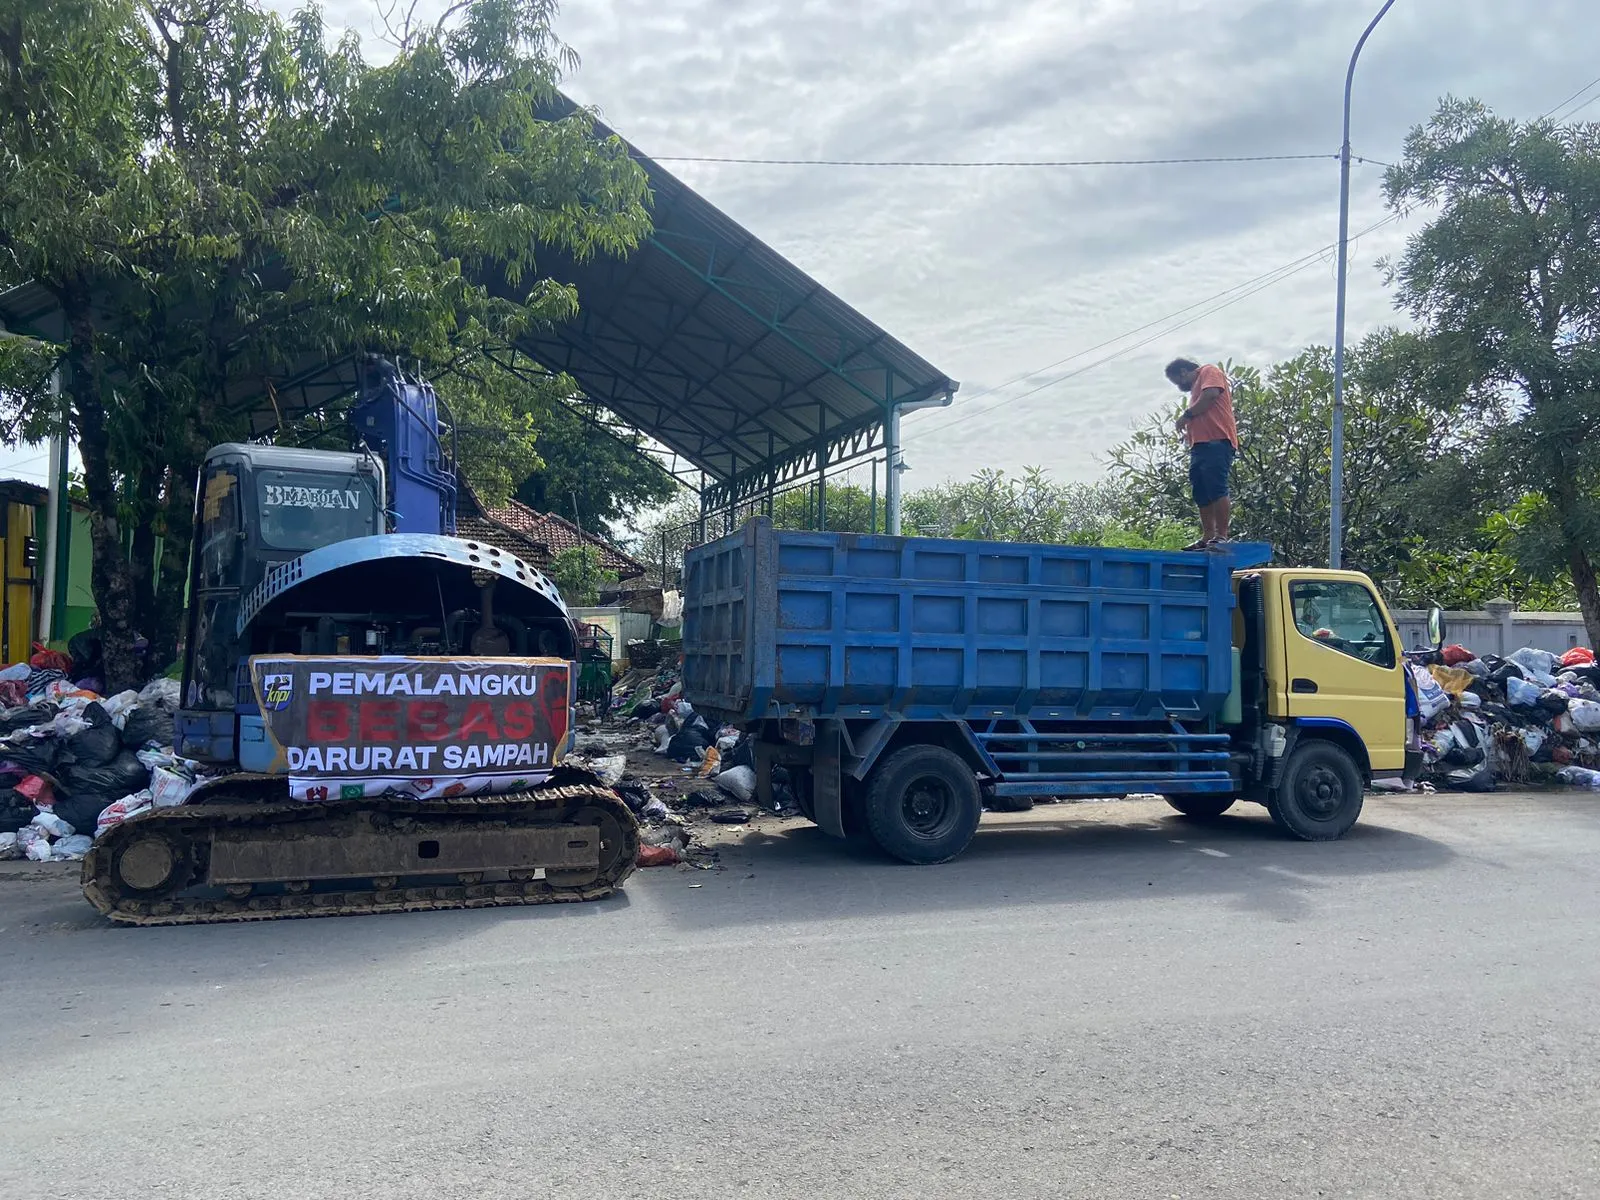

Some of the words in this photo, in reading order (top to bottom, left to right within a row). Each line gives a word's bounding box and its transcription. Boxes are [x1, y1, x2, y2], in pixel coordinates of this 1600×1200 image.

[309, 672, 537, 696] PEMALANGKU
[307, 700, 535, 742] BEBAS
[287, 745, 437, 772] DARURAT
[443, 742, 548, 770] SAMPAH
